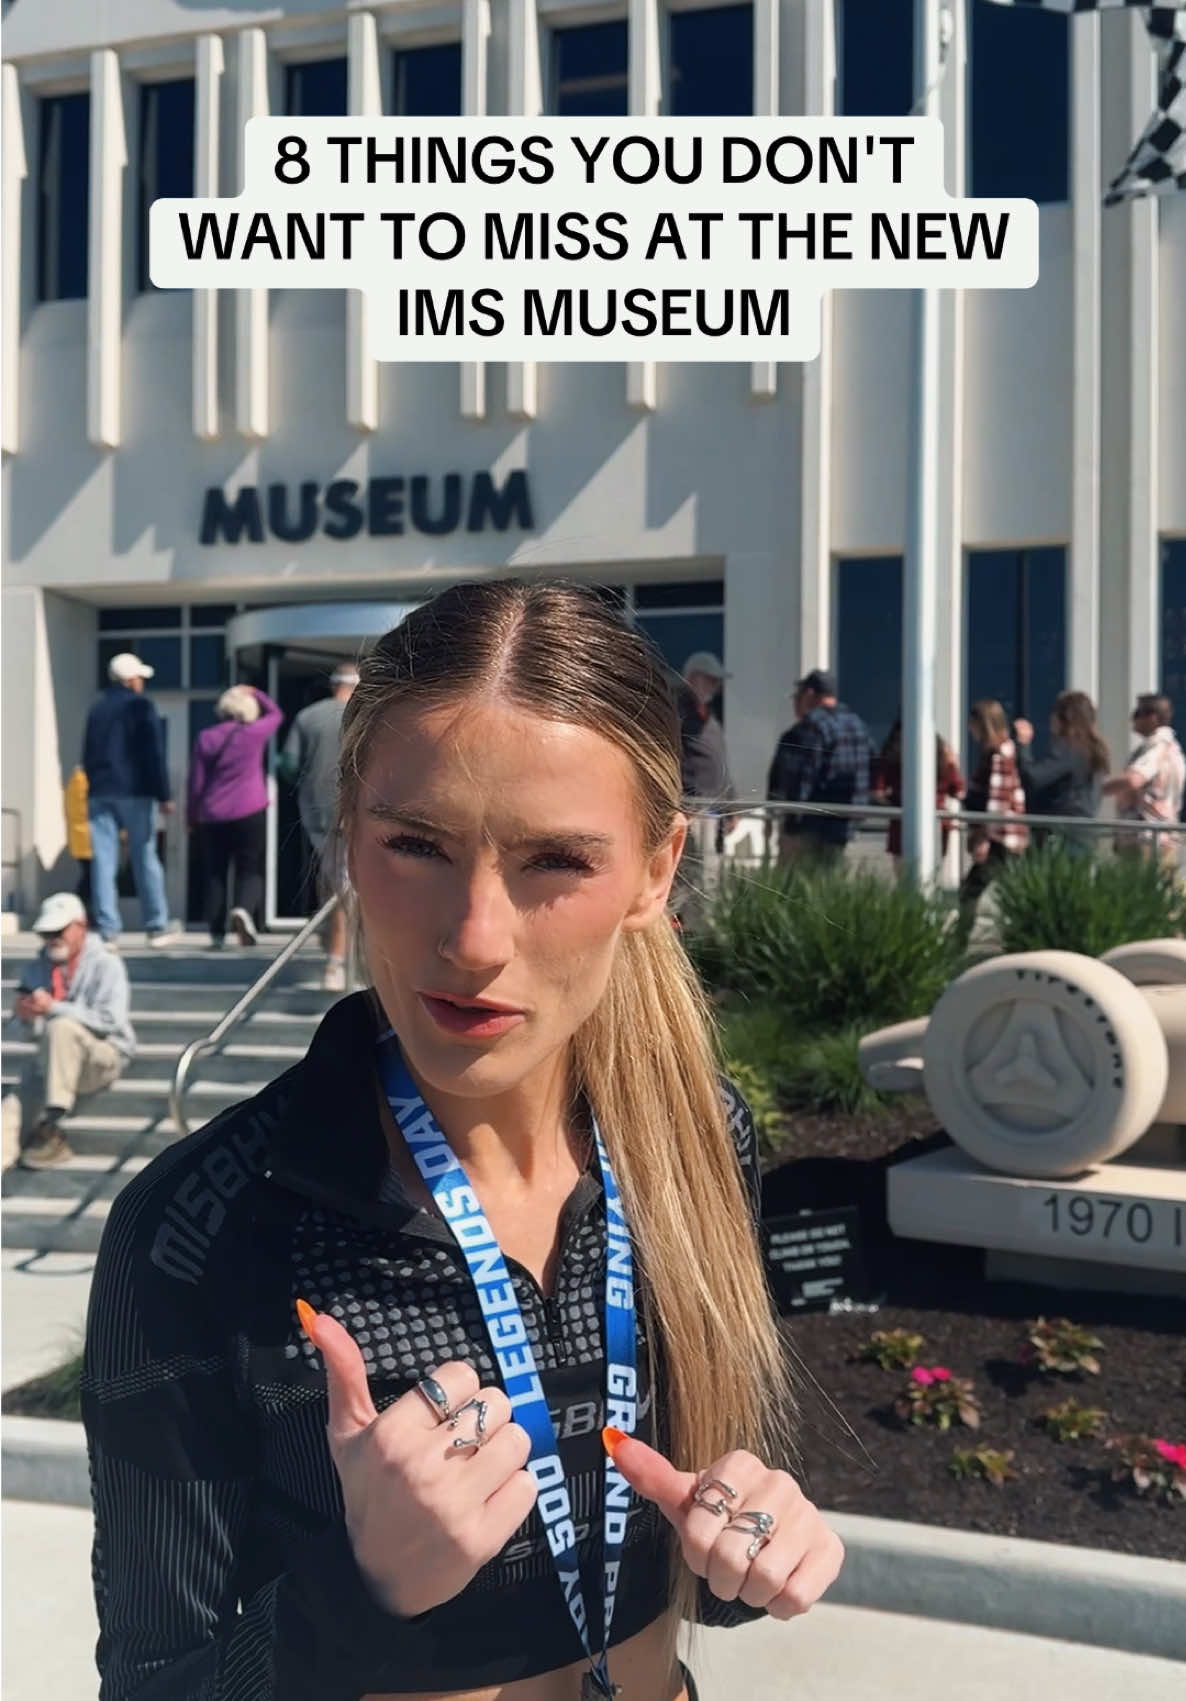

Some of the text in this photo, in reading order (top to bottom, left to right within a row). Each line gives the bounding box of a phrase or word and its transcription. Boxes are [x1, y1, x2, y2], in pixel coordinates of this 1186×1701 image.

[200, 470, 536, 545] MUSEUM
[388, 1095, 462, 1179] DAY
[1043, 1192, 1153, 1244] 1970
[433, 1184, 546, 1409] LEGENDS
[605, 1363, 637, 1545] GRND
[527, 1454, 576, 1558] 500
